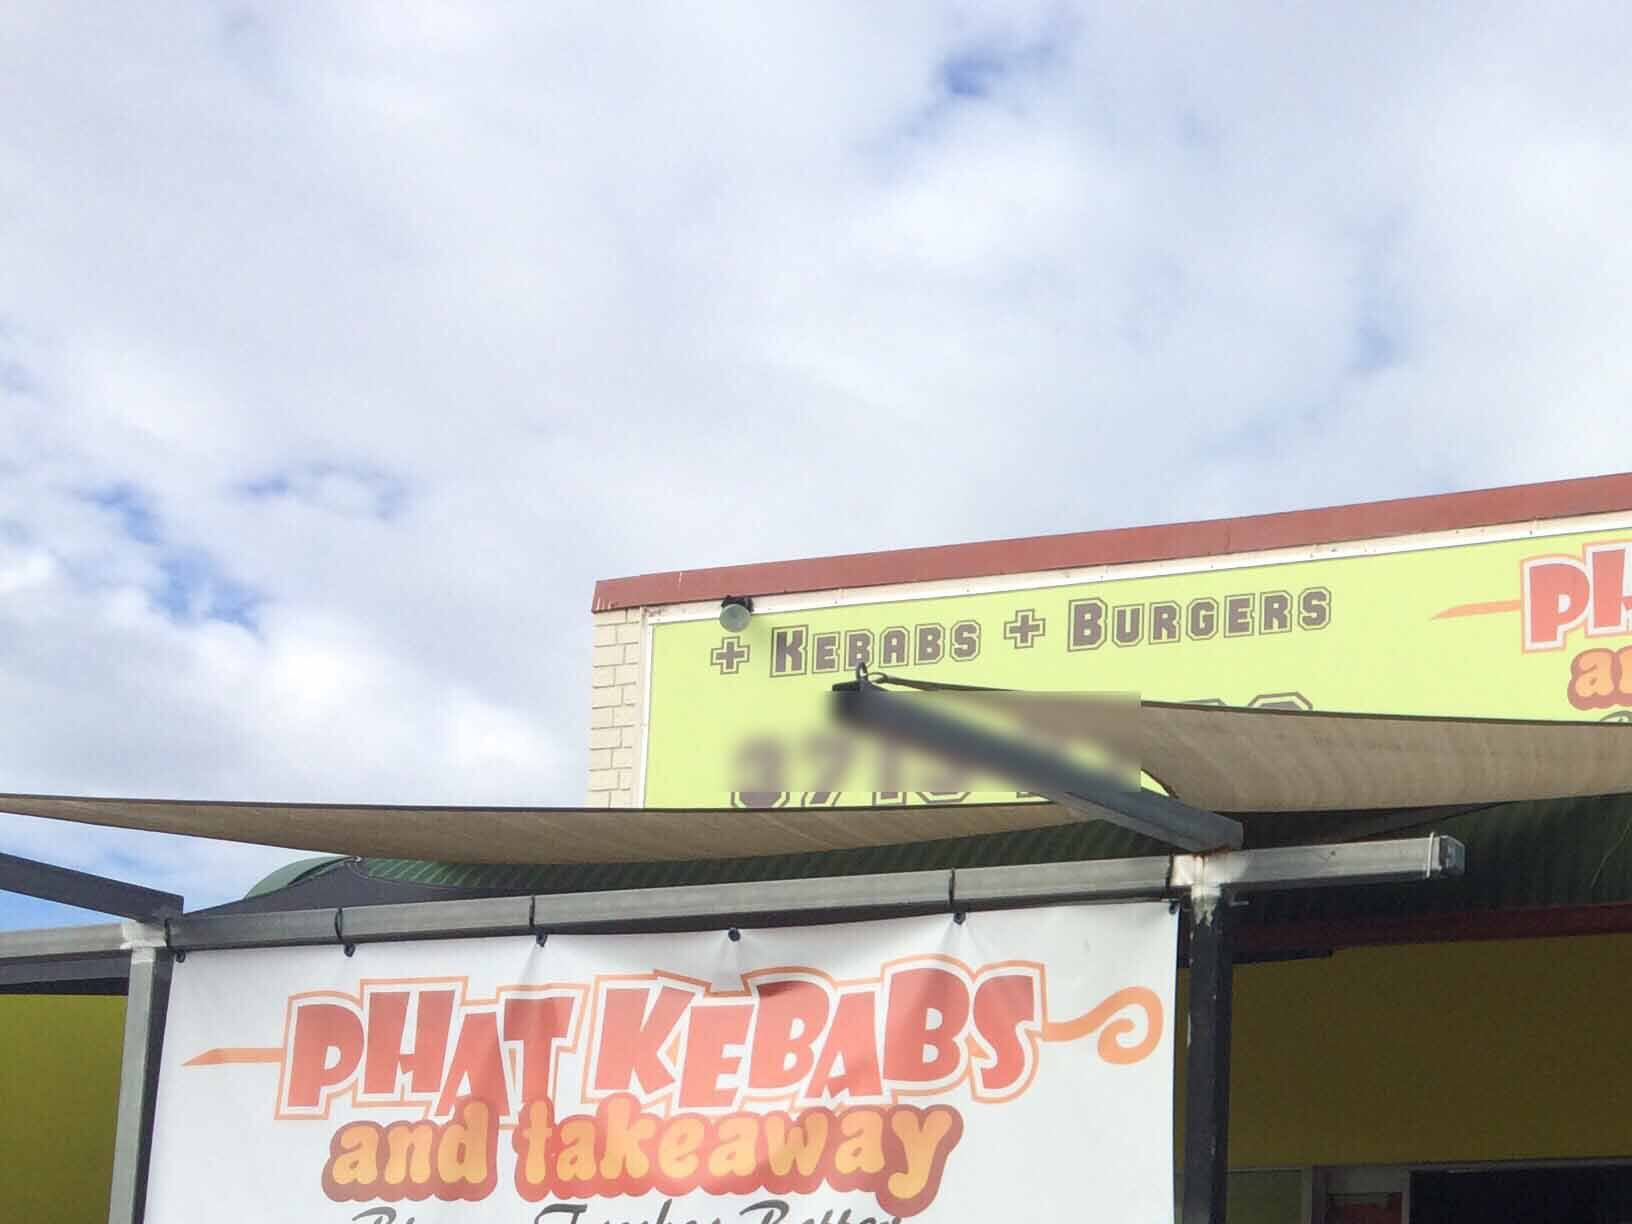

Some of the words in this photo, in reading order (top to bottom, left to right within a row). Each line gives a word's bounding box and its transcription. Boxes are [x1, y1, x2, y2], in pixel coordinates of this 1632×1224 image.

[770, 620, 981, 678] KEBABS
[1067, 587, 1331, 652] BURGERS
[275, 976, 589, 1129] PHAT
[583, 954, 1044, 1116] KEBABS
[322, 1094, 499, 1201] and
[514, 1092, 963, 1217] takeaway
